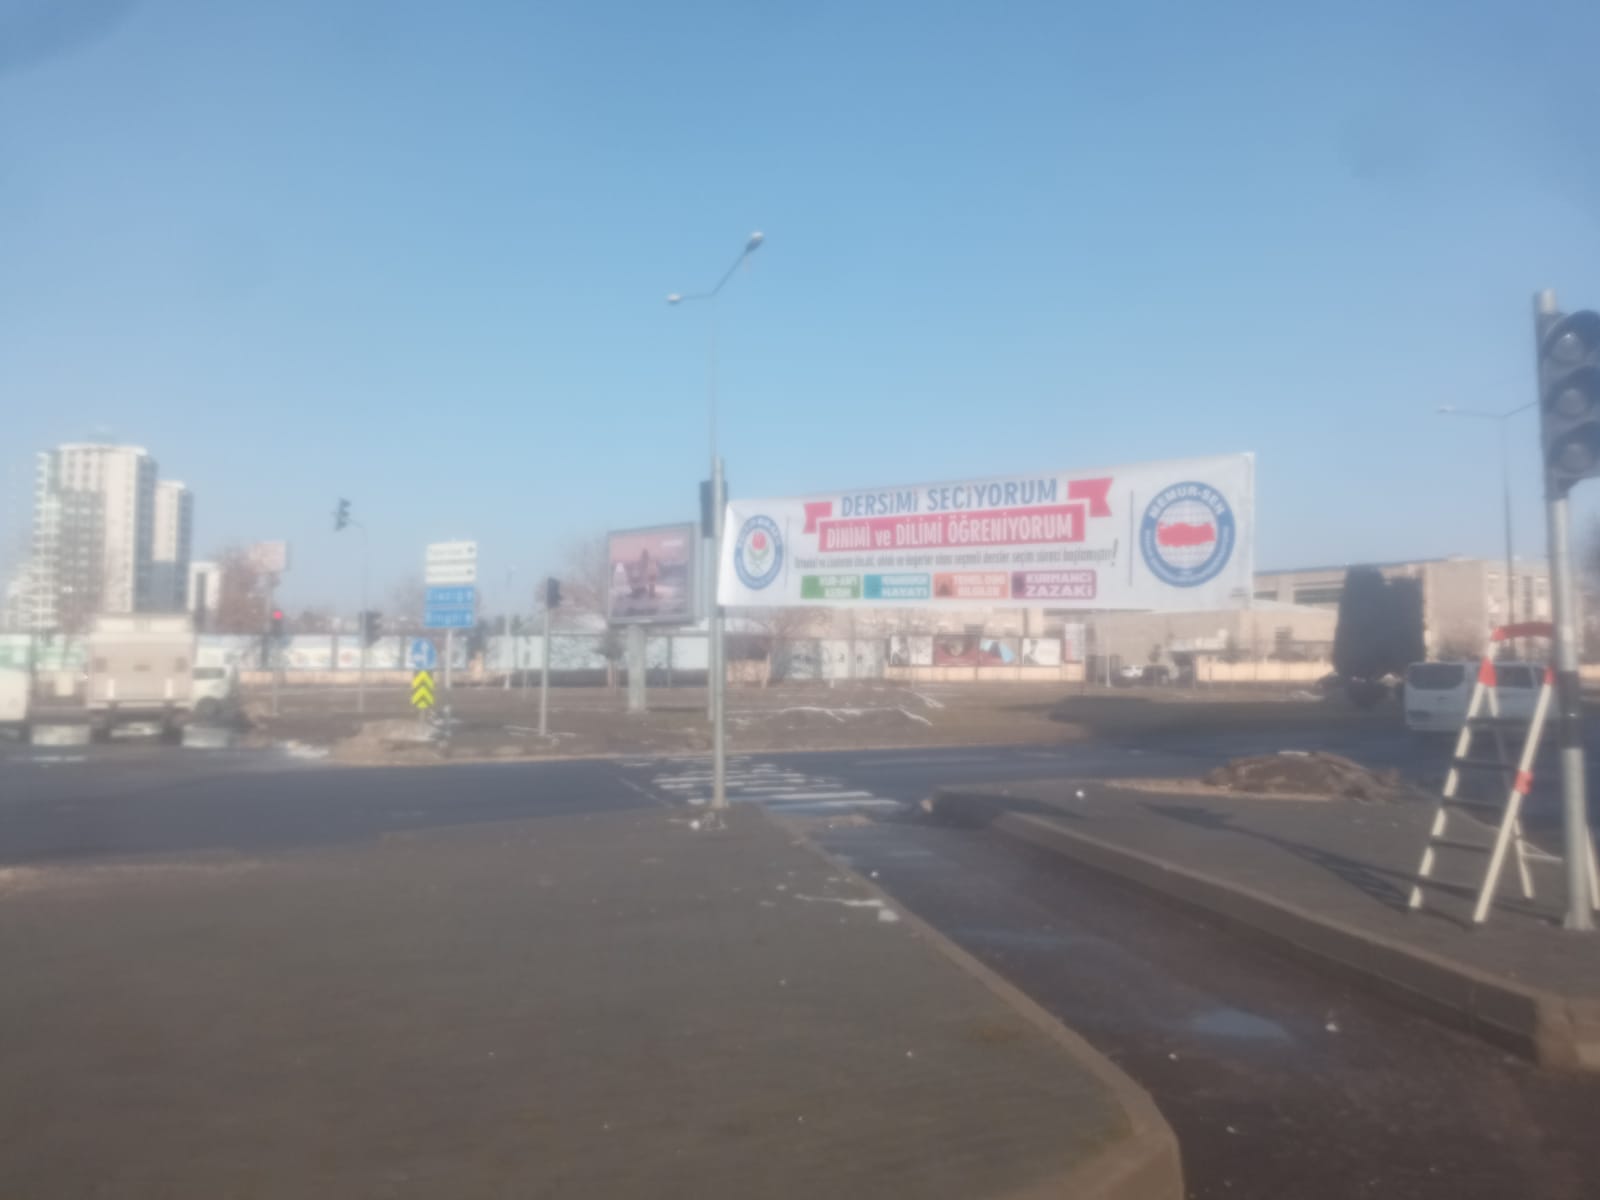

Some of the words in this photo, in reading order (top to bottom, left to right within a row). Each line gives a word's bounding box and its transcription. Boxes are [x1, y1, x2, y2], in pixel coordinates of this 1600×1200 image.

[1148, 486, 1226, 519] MEMUR-SEN
[826, 521, 871, 550] DİNİMİ
[874, 529, 892, 548] ve
[895, 516, 943, 547] DİLİMİ
[946, 512, 1073, 545] ÖĞRENİYORUM
